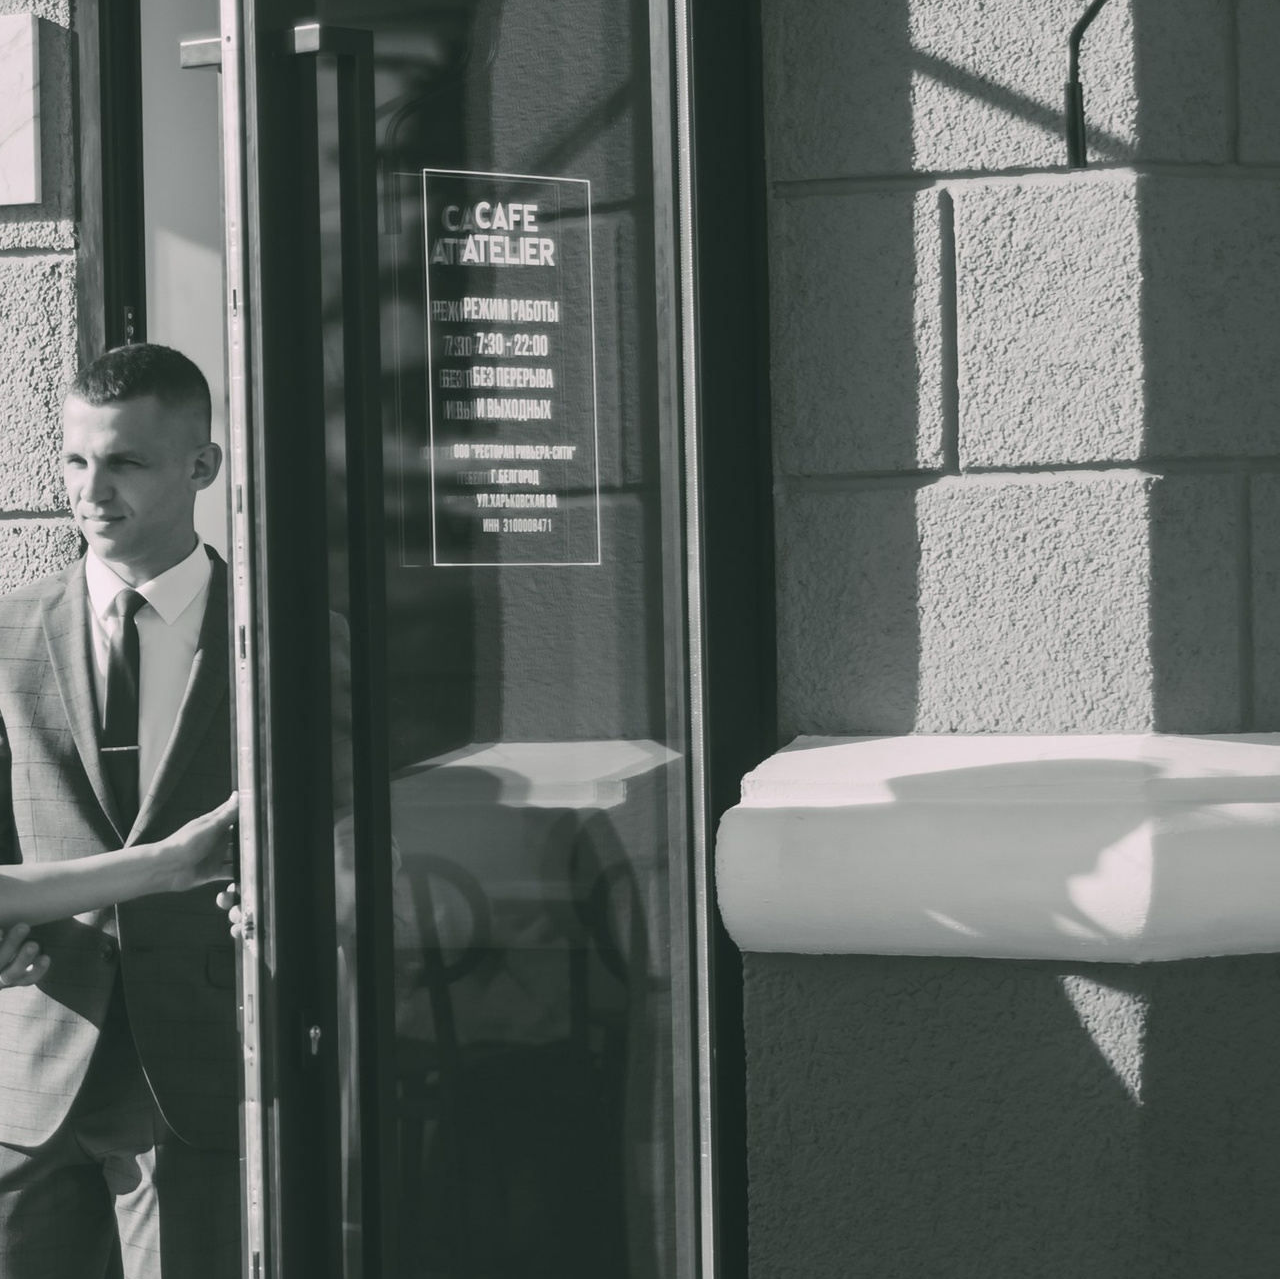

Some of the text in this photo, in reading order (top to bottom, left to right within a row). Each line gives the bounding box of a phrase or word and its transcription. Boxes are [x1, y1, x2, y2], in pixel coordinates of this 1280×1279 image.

[474, 201, 539, 233] CAFE
[462, 233, 555, 267] ATELIER
[463, 297, 559, 323] РЕЖИМ РАБОТЫ
[476, 332, 503, 355] 7:30
[514, 333, 548, 357] 22:00
[472, 366, 554, 389] БЕЗ ПЕРЕРЫВА
[476, 398, 552, 421] И ВЫХОДНЫХ
[482, 518, 500, 533] ИНН
